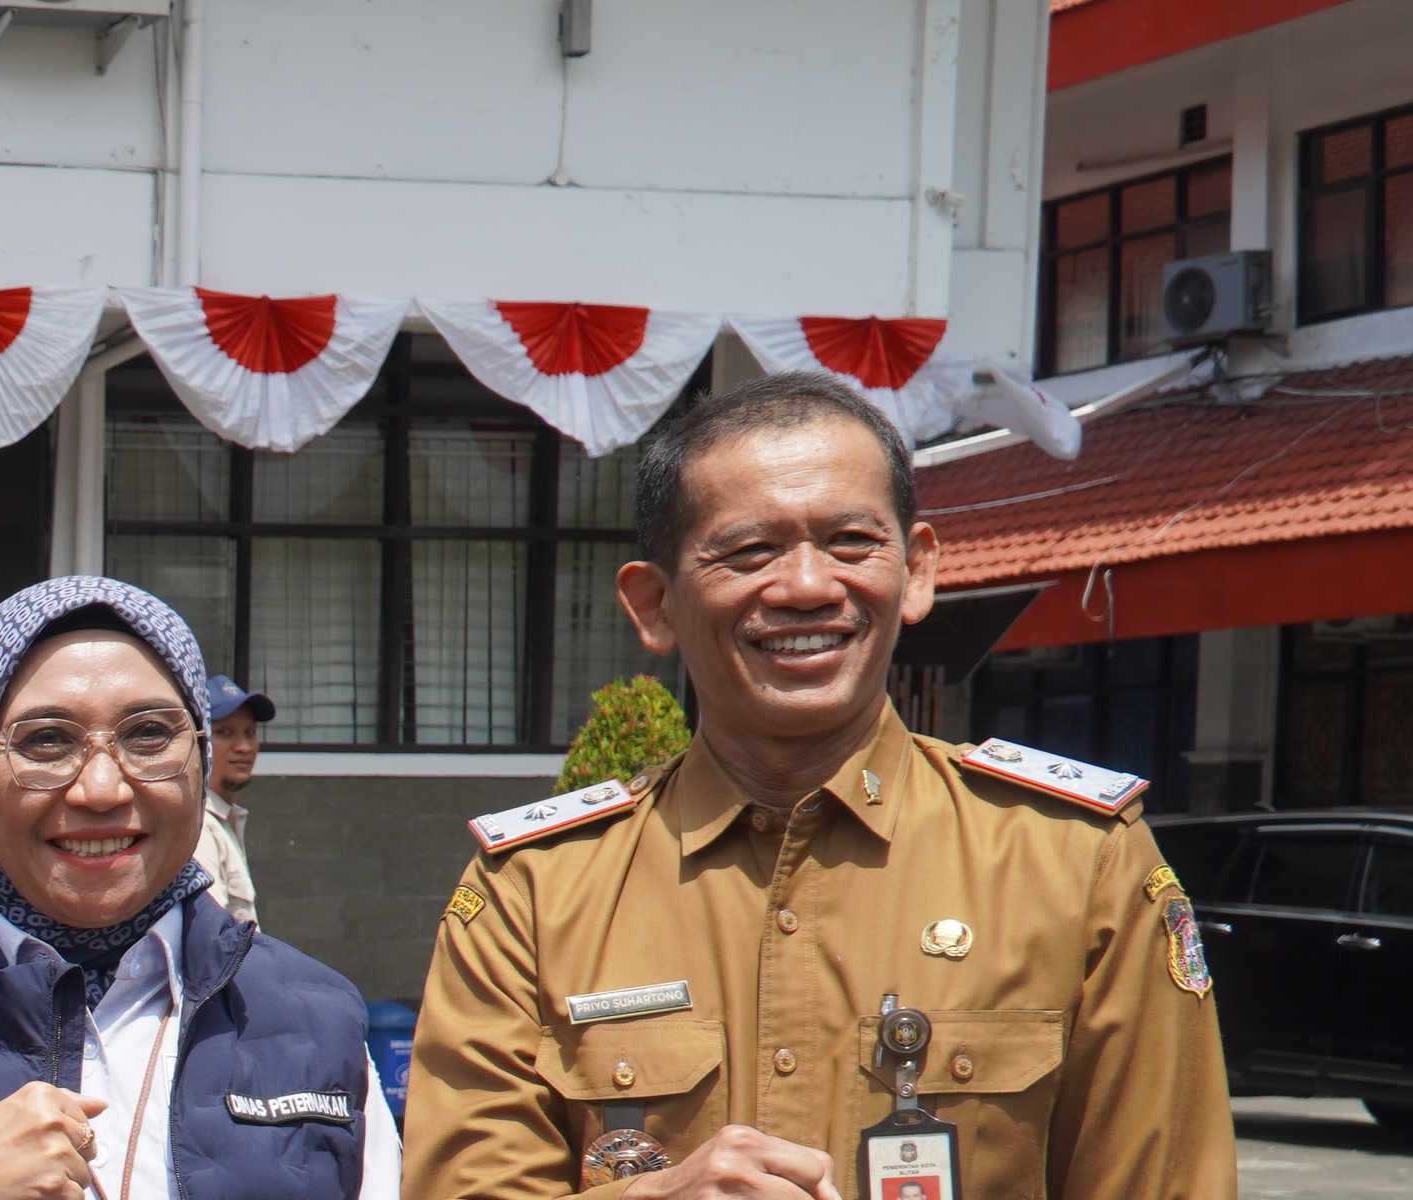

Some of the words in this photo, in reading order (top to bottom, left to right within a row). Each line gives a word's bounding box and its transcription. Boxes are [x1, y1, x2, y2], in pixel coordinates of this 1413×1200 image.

[576, 1000, 610, 1014] PRIYO
[613, 990, 684, 1009] SUHARTONO
[230, 1094, 267, 1117] DINAS
[268, 1092, 349, 1118] PETERNAKAN
